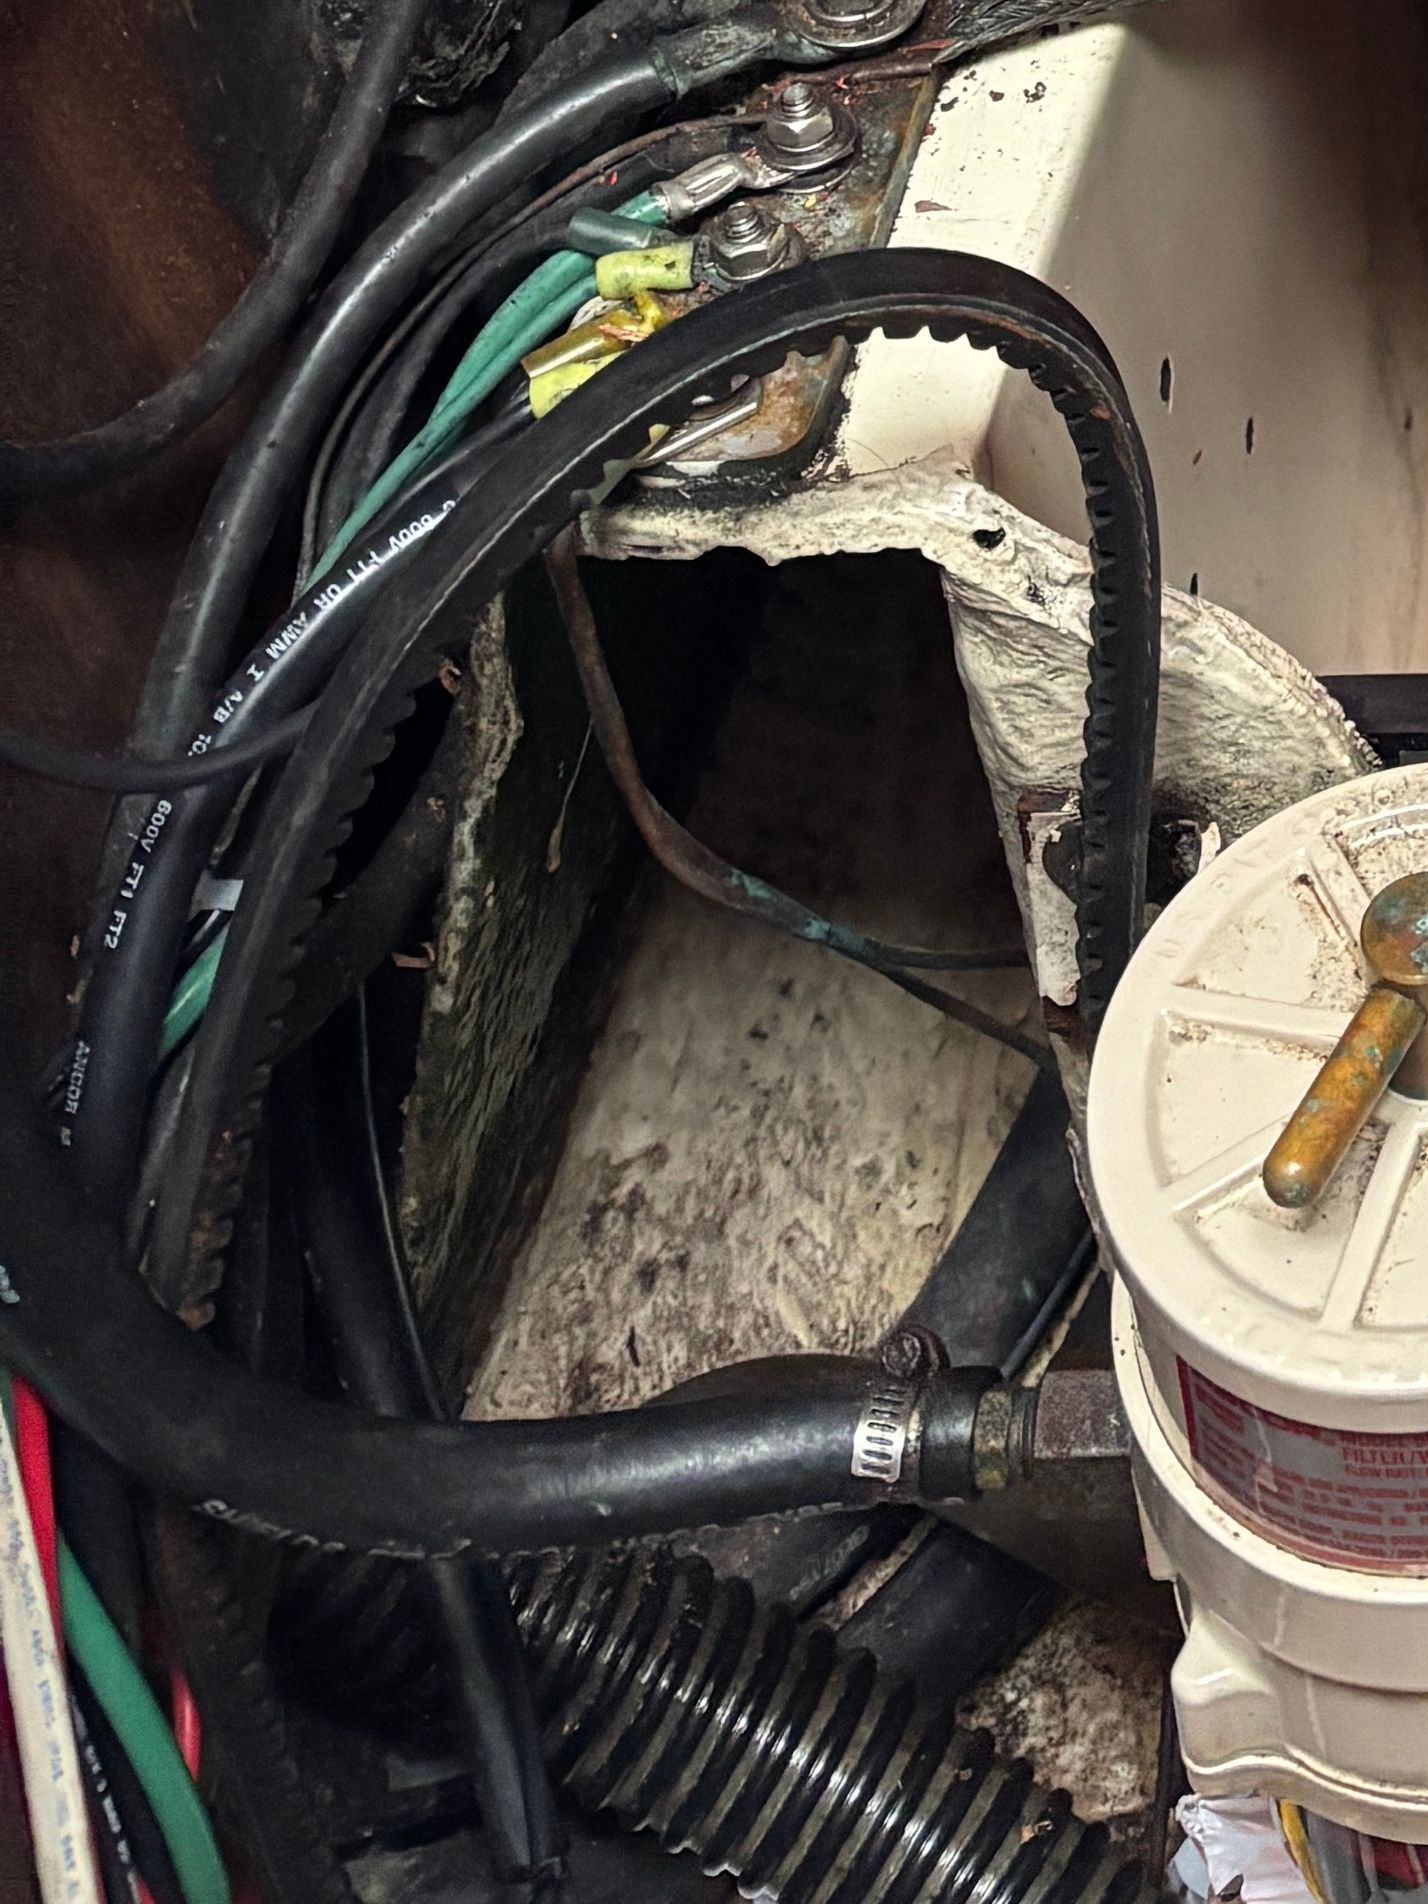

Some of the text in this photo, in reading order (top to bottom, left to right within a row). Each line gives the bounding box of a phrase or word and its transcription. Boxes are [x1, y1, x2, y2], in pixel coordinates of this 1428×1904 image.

[264, 611, 308, 661] AWM
[139, 798, 173, 854] 600V
[120, 863, 146, 899] FT1
[103, 910, 128, 951] FT2
[63, 1040, 92, 1115] ANCOR
